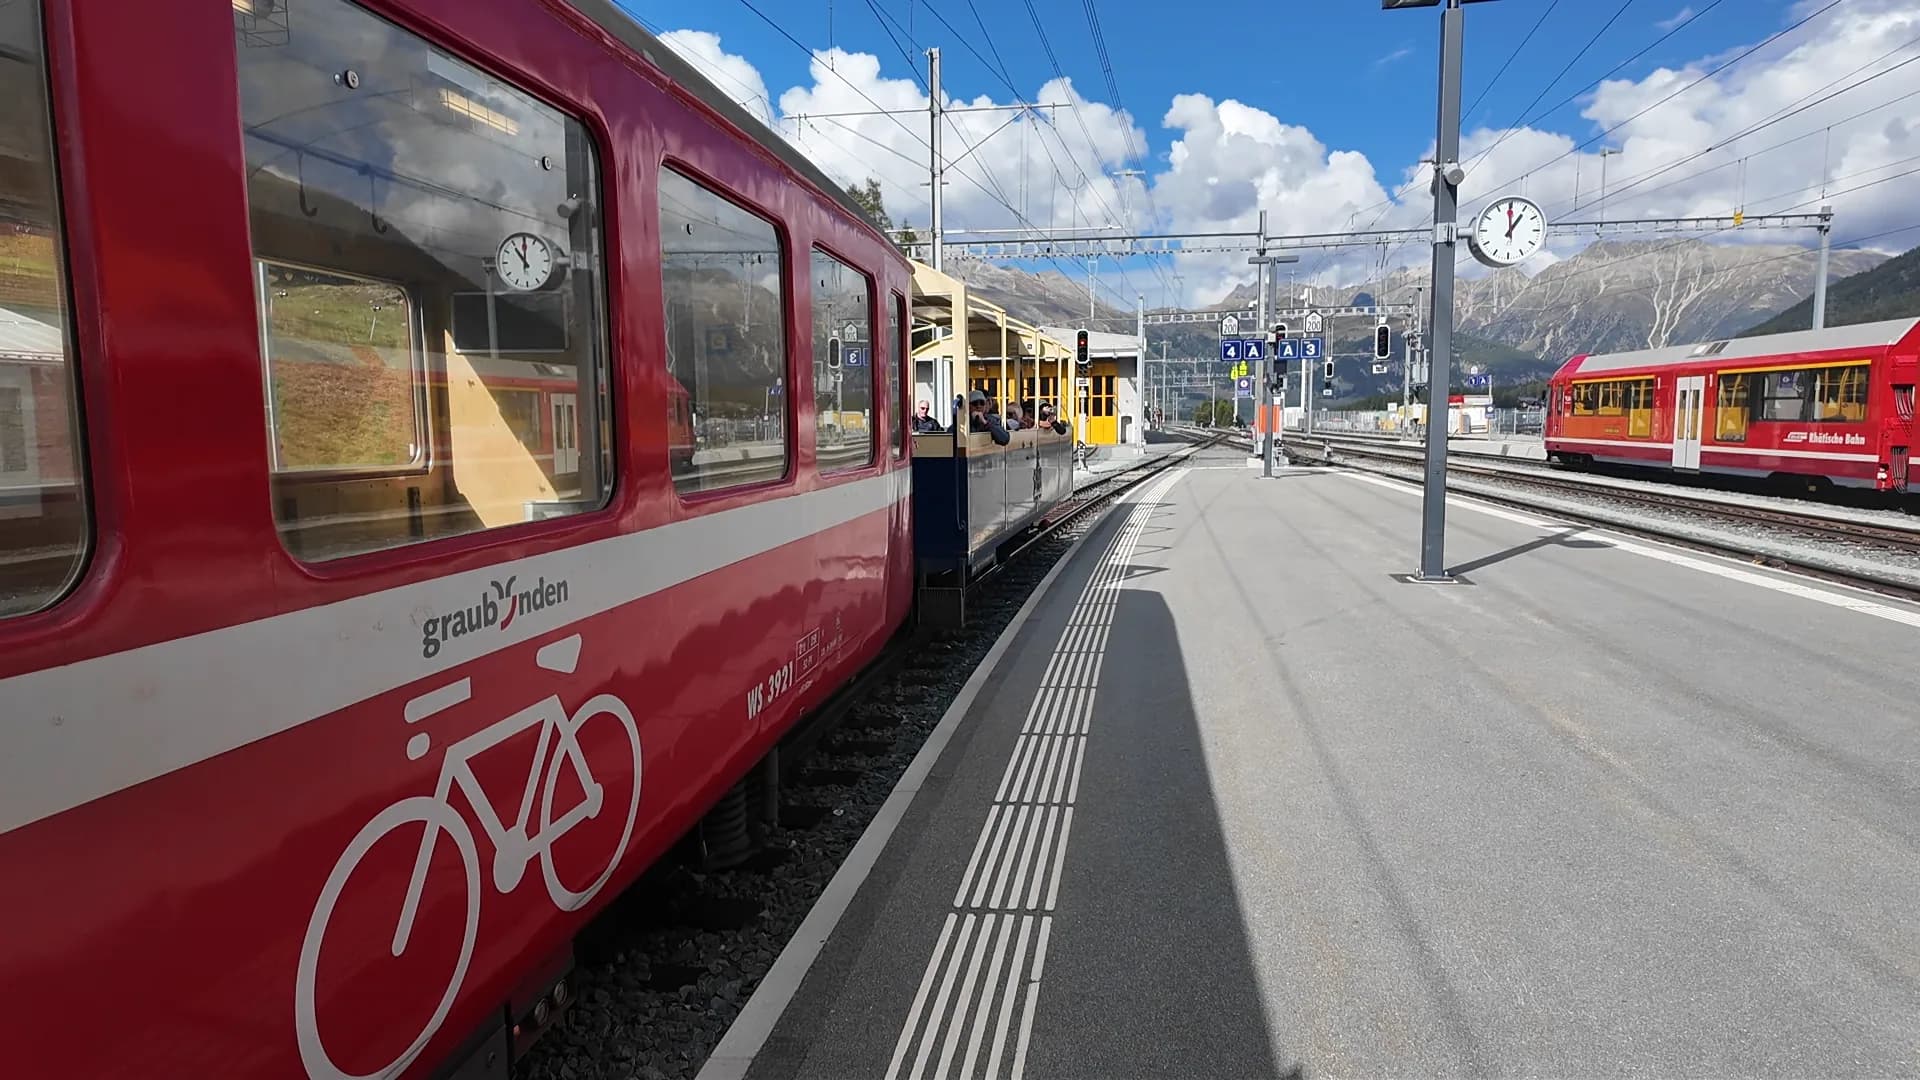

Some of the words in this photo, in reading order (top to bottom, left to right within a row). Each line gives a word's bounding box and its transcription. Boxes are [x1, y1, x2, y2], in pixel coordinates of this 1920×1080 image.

[1224, 323, 1237, 334] 200
[1307, 320, 1320, 331] 200
[1227, 346, 1236, 357] 4
[1248, 345, 1259, 357] A
[1283, 344, 1293, 356] A
[1306, 343, 1315, 355] 3
[1844, 433, 1865, 446] Bahn
[747, 682, 763, 721] WS
[767, 660, 793, 704] 3921
